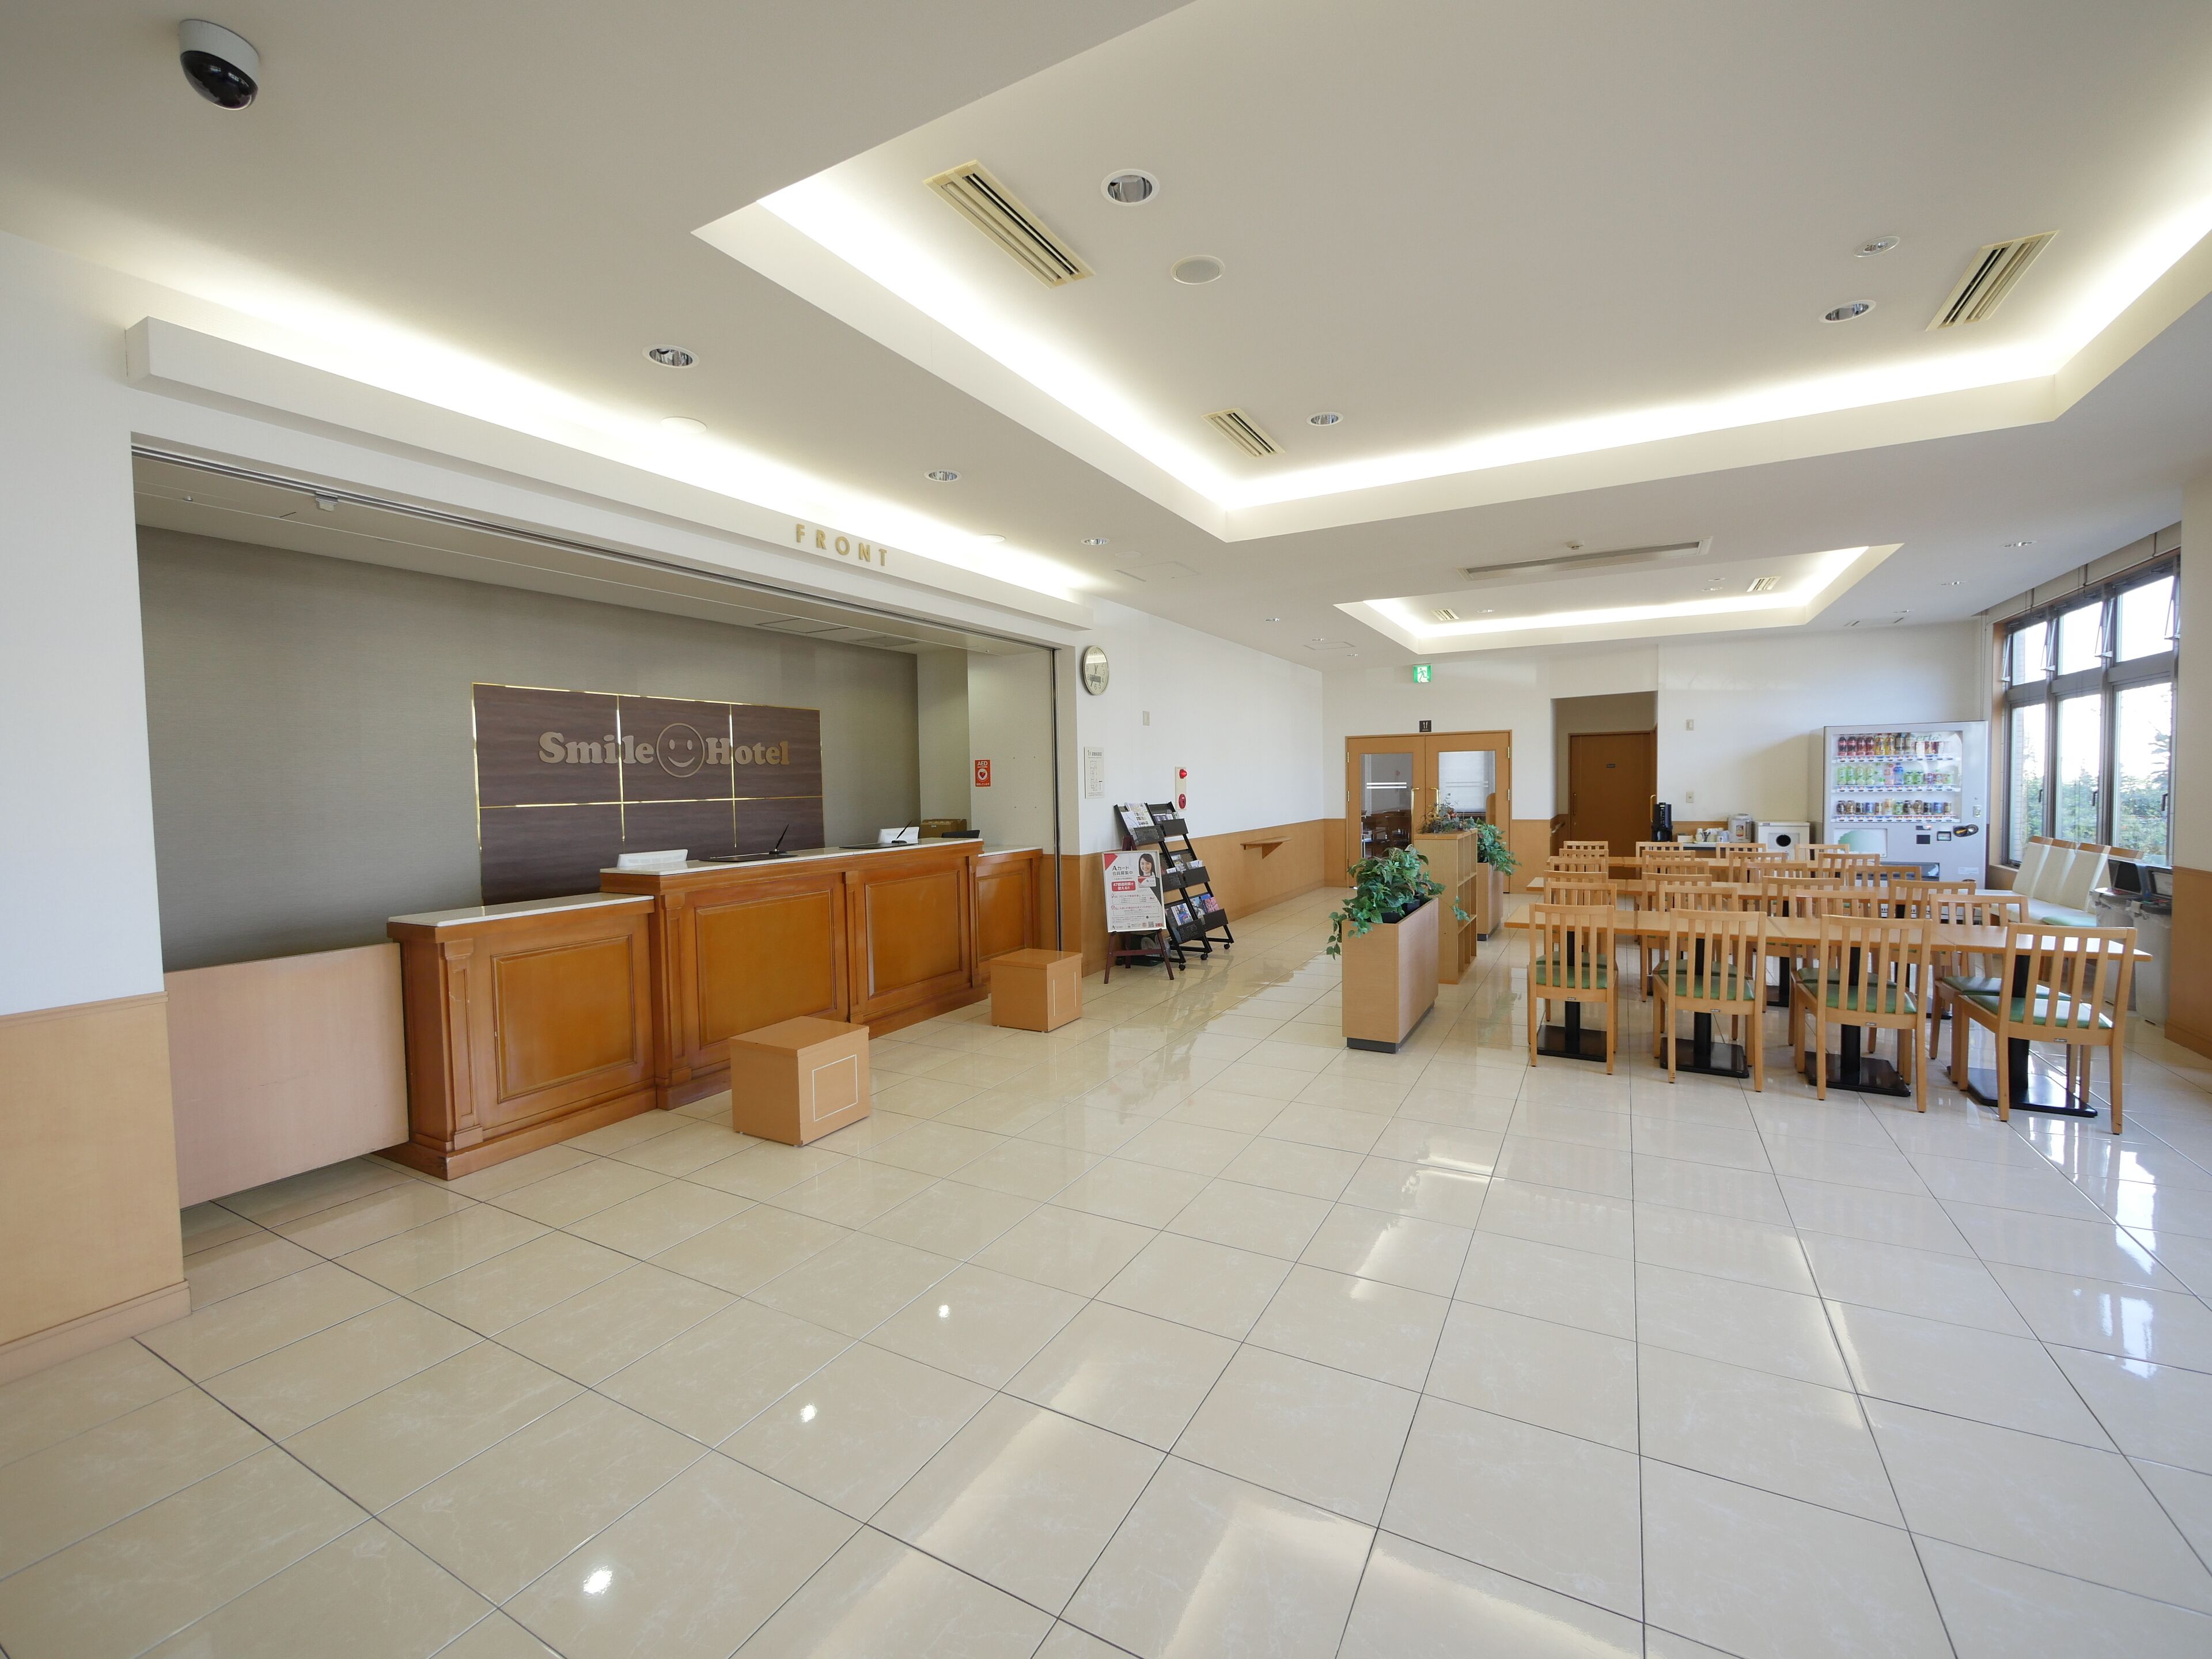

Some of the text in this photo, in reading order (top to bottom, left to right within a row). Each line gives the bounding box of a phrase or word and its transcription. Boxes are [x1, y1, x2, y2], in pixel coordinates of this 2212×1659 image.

[796, 524, 887, 566] FRONT
[539, 732, 790, 765] Smile Hotel
